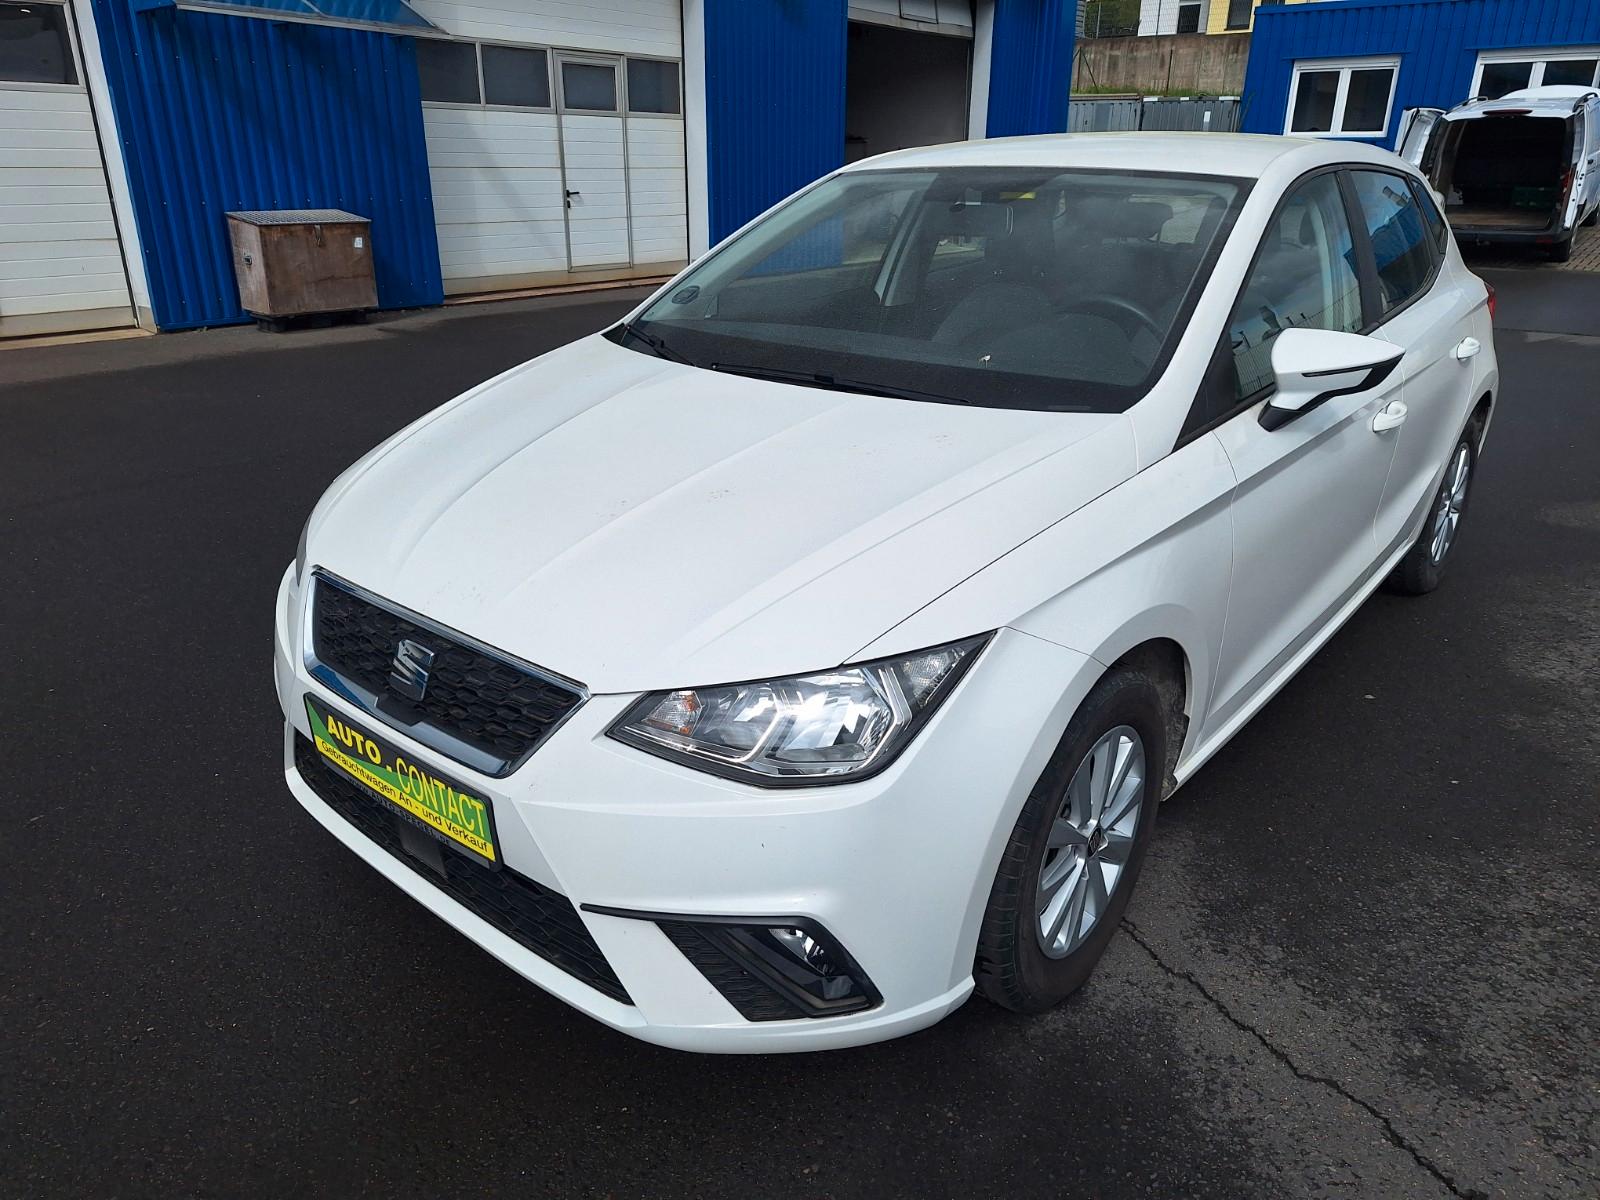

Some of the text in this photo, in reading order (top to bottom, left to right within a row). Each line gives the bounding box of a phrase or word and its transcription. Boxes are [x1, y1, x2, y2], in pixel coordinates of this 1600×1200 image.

[321, 741, 396, 796] Gebrauchtwagen
[400, 792, 413, 808] An
[422, 810, 442, 826] und
[445, 821, 488, 852] Verkauf
[327, 715, 381, 764] AUTO
[396, 758, 484, 838] CONTACT
